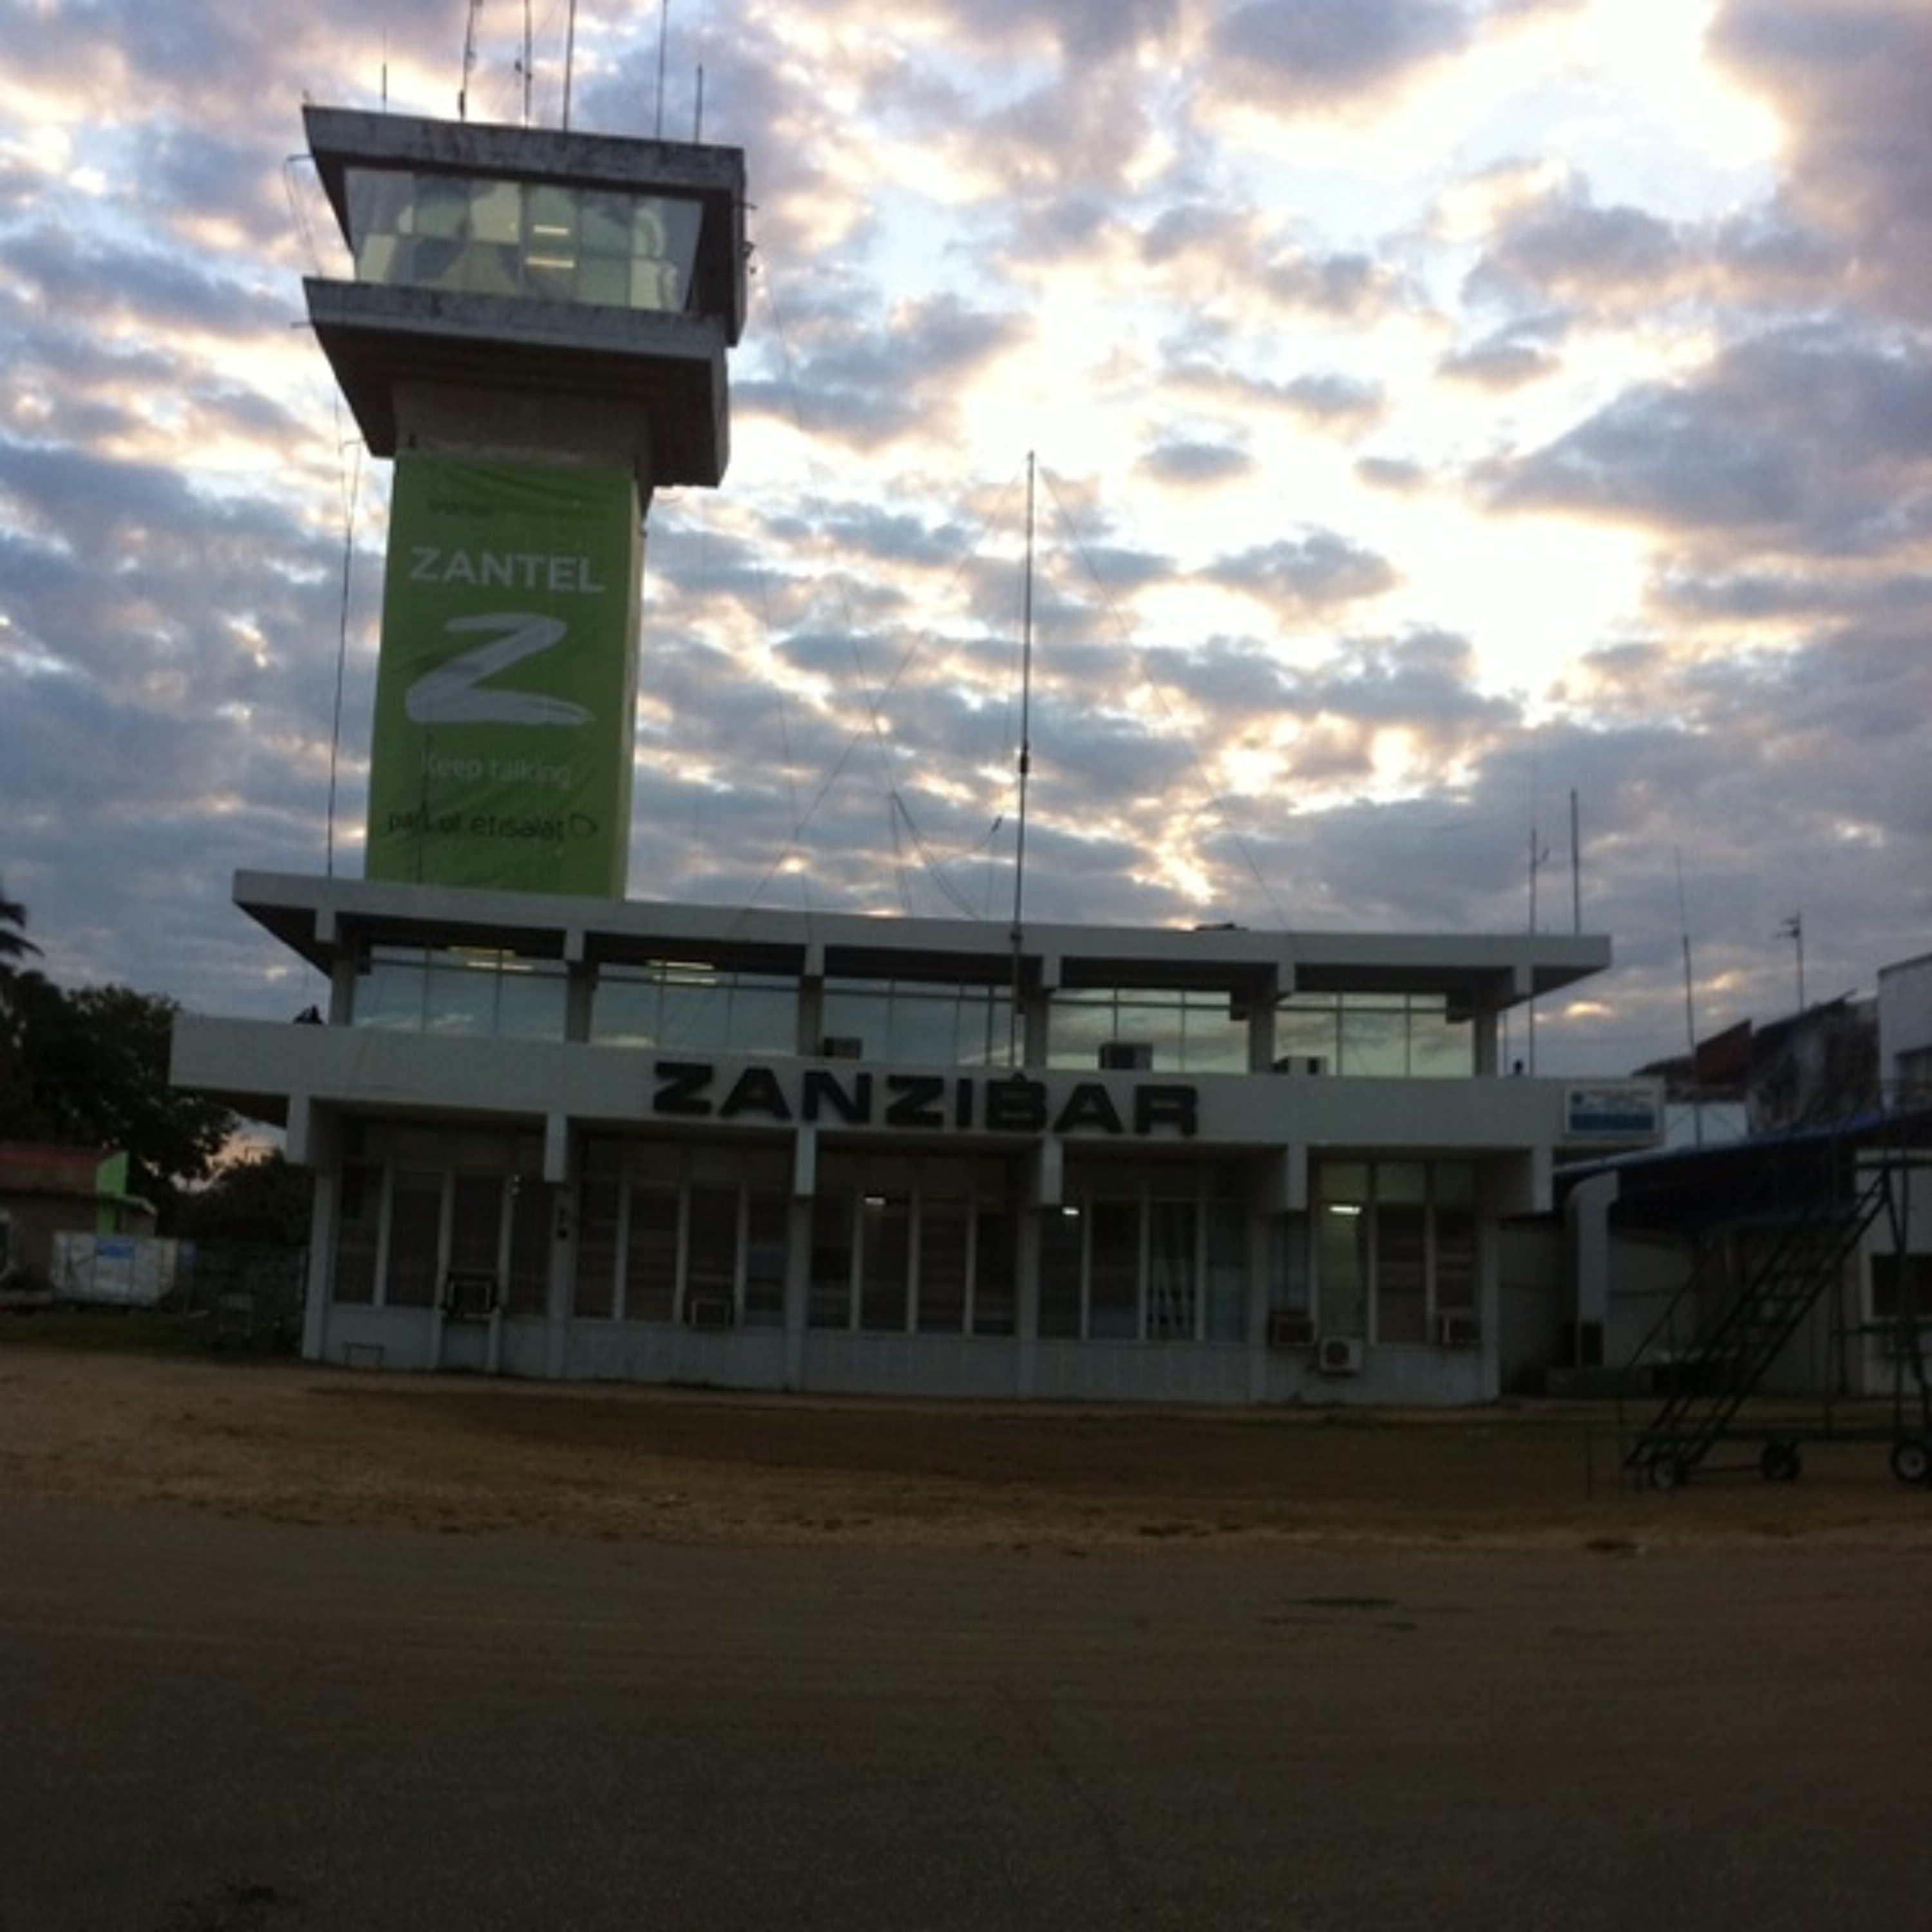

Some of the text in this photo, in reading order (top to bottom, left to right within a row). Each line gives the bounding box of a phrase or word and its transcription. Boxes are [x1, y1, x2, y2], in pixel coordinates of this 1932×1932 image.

[410, 545, 606, 594] ZANTEL
[439, 811, 462, 833] of
[652, 1061, 1198, 1138] ZANZIBAR
